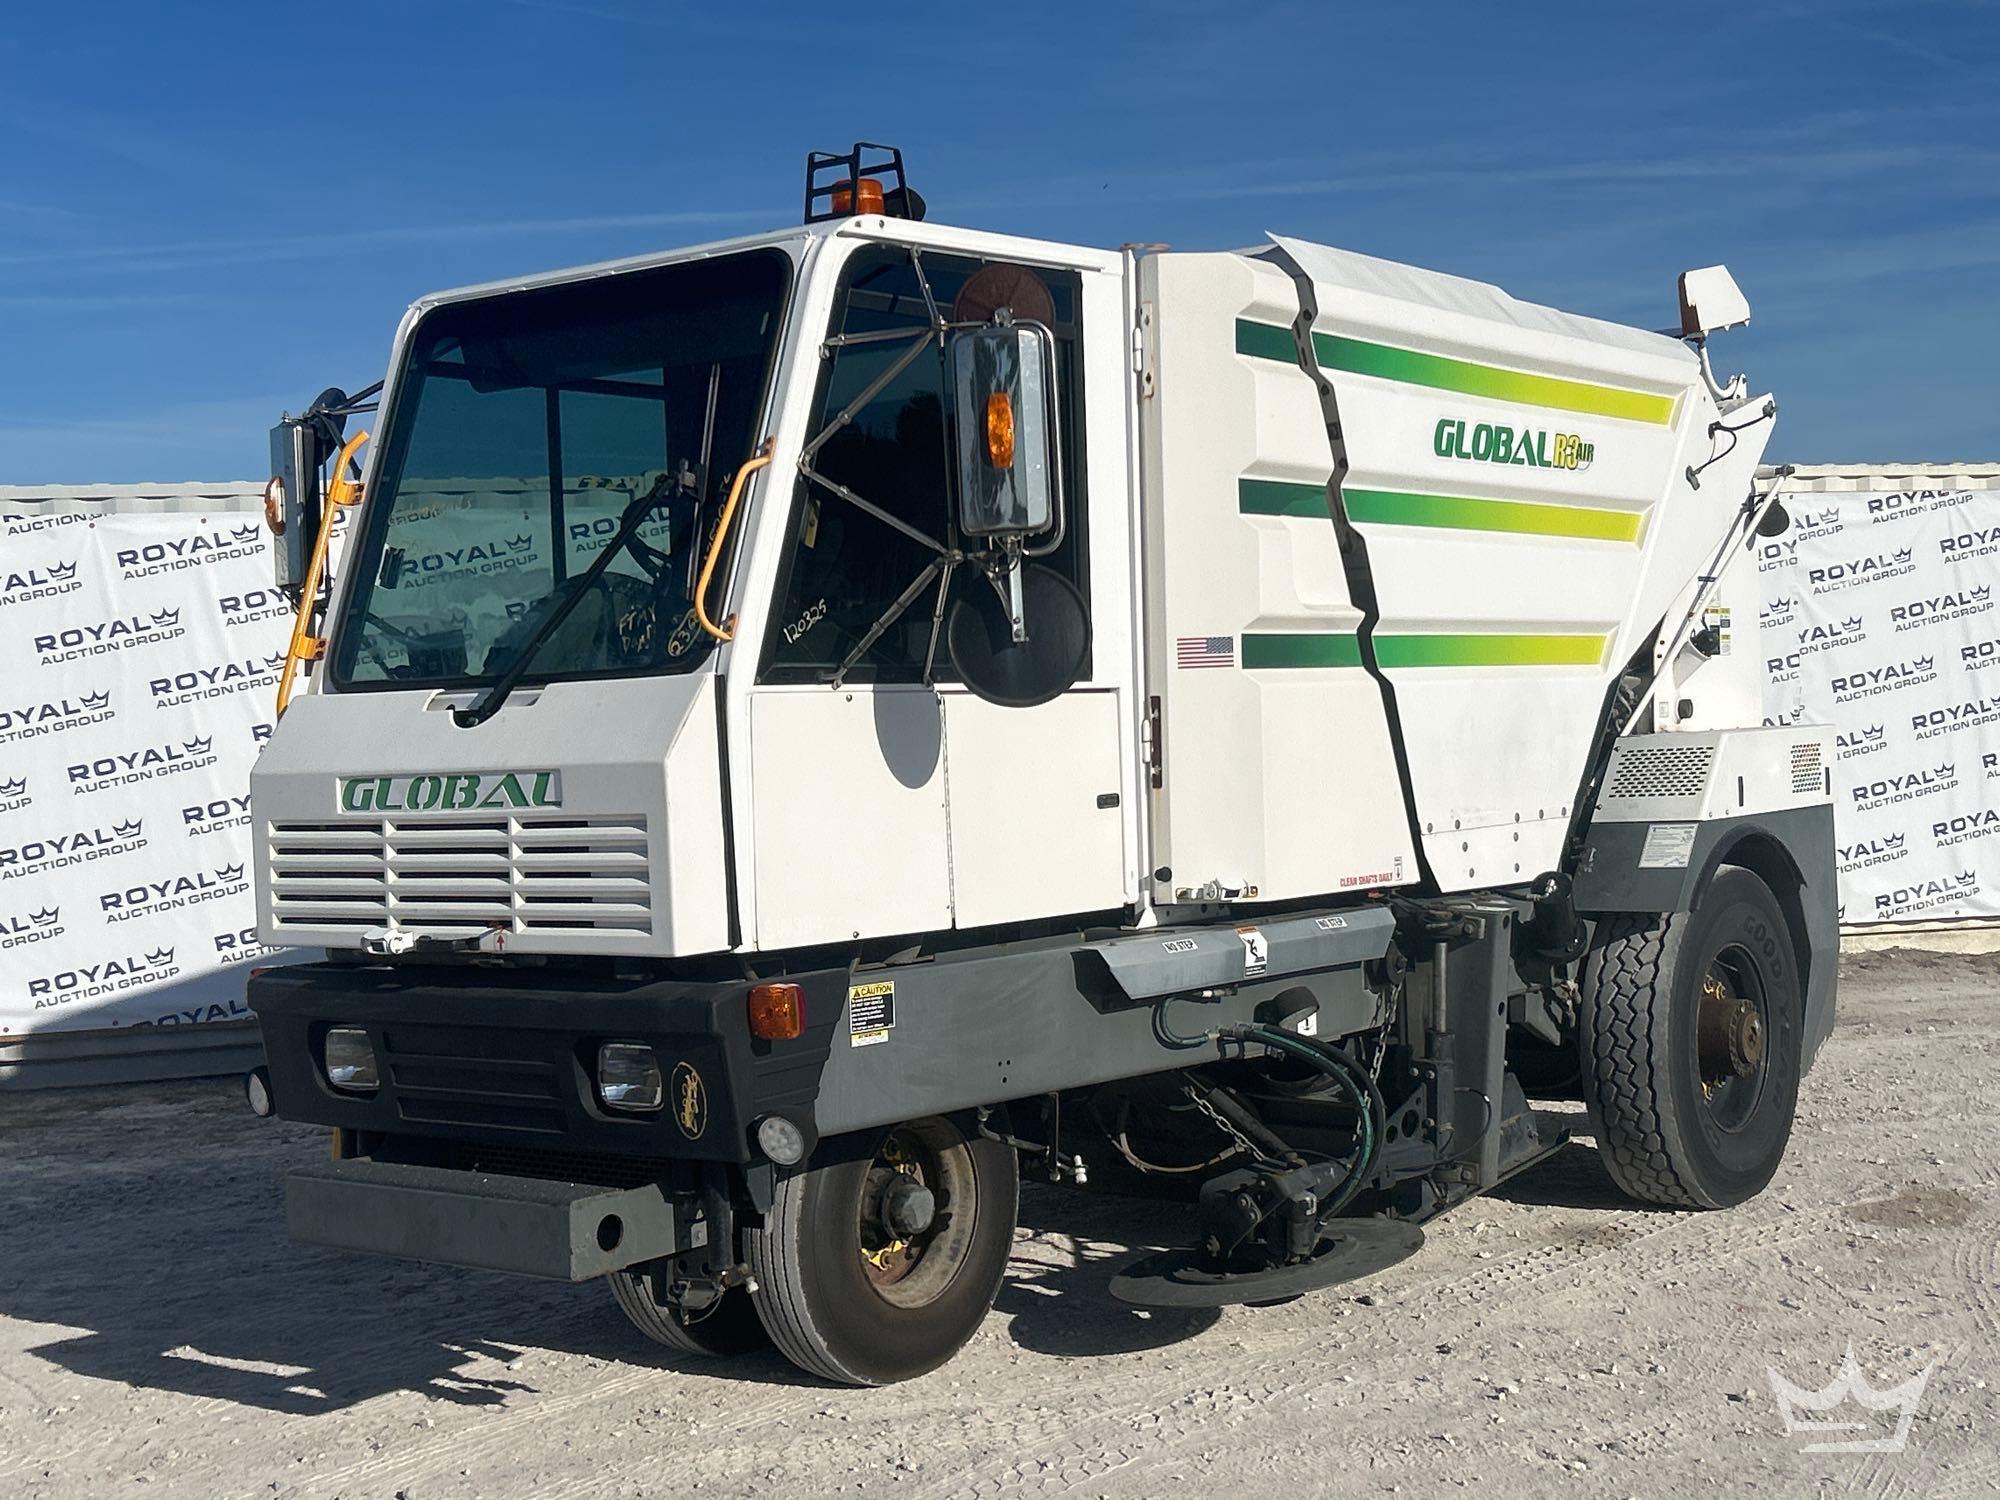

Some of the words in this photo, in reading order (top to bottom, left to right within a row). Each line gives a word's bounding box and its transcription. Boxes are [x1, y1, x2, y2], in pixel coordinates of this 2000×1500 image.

[1433, 418, 1552, 468] GLOBAL
[1576, 443, 1595, 462] AIR
[8, 513, 87, 536] AUCTION
[1872, 505, 1927, 524] AUCTION
[1798, 524, 1844, 541] GROUP
[117, 532, 231, 568] ROYAL
[124, 557, 201, 581] AUCTION
[205, 544, 266, 565] GROUP
[401, 542, 506, 576] ROYAL
[1758, 557, 1798, 572] UCTIO
[1944, 545, 1998, 564] AUCTION
[404, 566, 477, 589] AUCTION
[481, 553, 538, 573] GROUP
[1809, 555, 1893, 584] ROYAL
[1813, 575, 1870, 595] AUCTION
[1872, 564, 1916, 581] GROUP
[20, 581, 82, 602] GROUP
[219, 589, 286, 614] ROY
[1760, 614, 1794, 629] ROUP
[1890, 592, 1971, 622] ROYAL
[1895, 613, 1950, 632] AUCTION
[1951, 602, 1994, 619] GROUP
[34, 617, 151, 653] ROYAL
[41, 641, 120, 666] AUCTION
[123, 627, 186, 649] GROUP
[1798, 623, 1842, 643] YAL
[1821, 633, 1866, 650] GROUP
[150, 660, 265, 696] ROYAL
[1831, 662, 1914, 693] ROYAL
[1835, 683, 1892, 704] AUCTION
[1894, 672, 1938, 690] GROUP
[156, 685, 234, 709] AUCTION
[53, 711, 116, 732] GROUP
[1911, 700, 1992, 730] ROYAL
[1915, 721, 1970, 741] AUCTION
[1972, 713, 2000, 727] GRO
[67, 745, 184, 782] ROYAL
[1843, 741, 1888, 759] GROUP
[73, 770, 153, 795] AUCTION
[156, 755, 218, 777] GROUP
[1852, 770, 1935, 802] ROYAL
[341, 772, 562, 811] GLOBAL
[1856, 791, 1913, 812] AUCTION
[1915, 780, 1959, 797] GROUP
[182, 794, 252, 825] ROY
[188, 815, 252, 837] AUCTIO
[1936, 827, 1992, 848] AUCTION
[0, 828, 114, 867] ROYAL
[2, 854, 82, 880] AUCTION
[85, 838, 148, 861] GROUP
[1837, 840, 1884, 861] YAL
[1864, 849, 1909, 867] GROUP
[100, 873, 216, 911] ROYAL
[106, 897, 185, 924] AUCTION
[188, 883, 250, 905] GROUP
[1875, 878, 1957, 909] ROYAL
[1877, 898, 1935, 920] AUCTION
[1936, 887, 1981, 904] GROUP
[1, 926, 65, 949] GROUP
[1164, 942, 1178, 951] NO
[1176, 940, 1194, 950] STEP
[28, 956, 146, 997] ROYAL
[34, 982, 115, 1010] AUCTION
[118, 966, 181, 990] GROUP
[861, 985, 892, 996] CAUTION
[131, 1000, 248, 1027] OYAL
